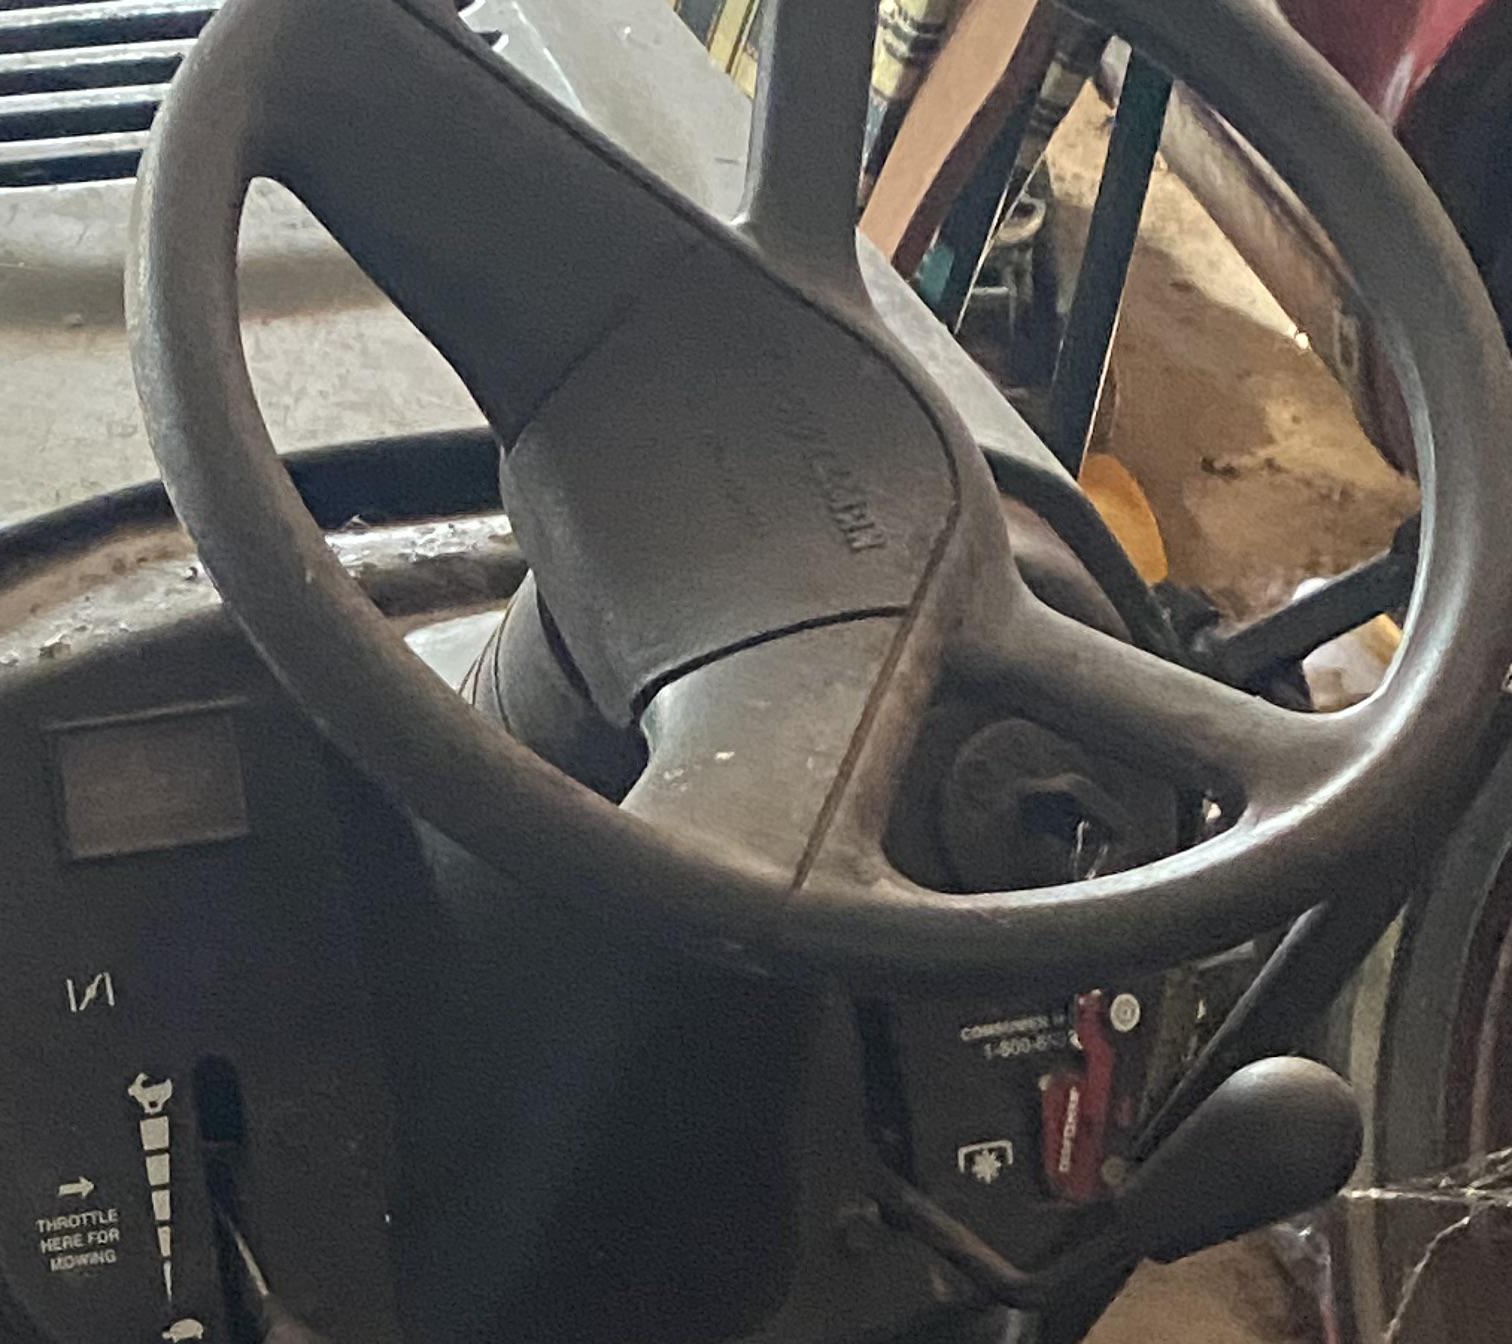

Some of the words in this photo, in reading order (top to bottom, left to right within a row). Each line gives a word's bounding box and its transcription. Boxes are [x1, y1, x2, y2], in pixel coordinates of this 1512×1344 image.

[36, 1208, 118, 1233] THROTTLE
[40, 1233, 83, 1254] HERE
[87, 1228, 120, 1244] FOR
[50, 1249, 117, 1271] MOWING
